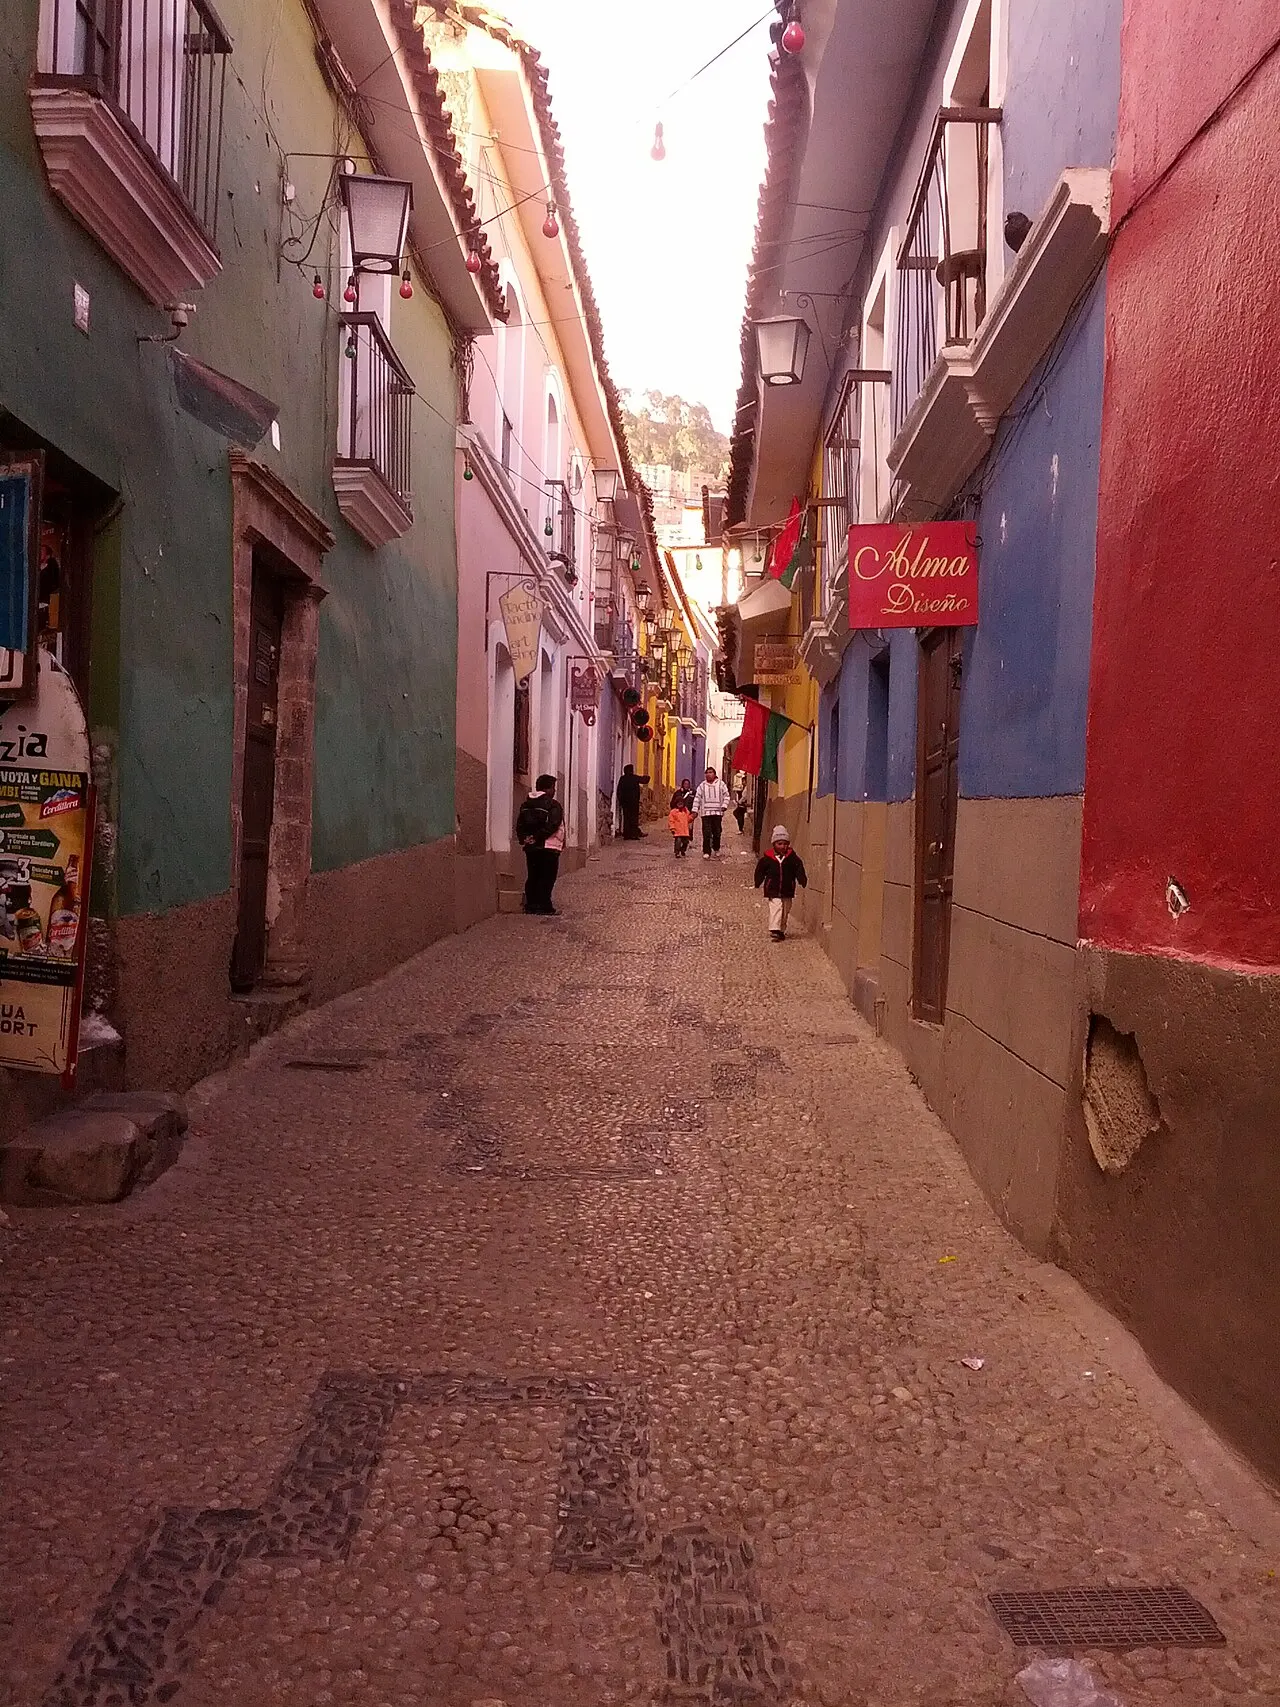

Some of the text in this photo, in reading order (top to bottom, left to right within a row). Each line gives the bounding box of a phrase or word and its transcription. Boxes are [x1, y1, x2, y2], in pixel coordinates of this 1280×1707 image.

[854, 530, 970, 580] Alma
[880, 583, 970, 614] Diseño
[0, 770, 30, 784] VOTA
[40, 772, 82, 788] GANA
[17, 858, 30, 881] 3
[0, 1020, 38, 1037] ORT
